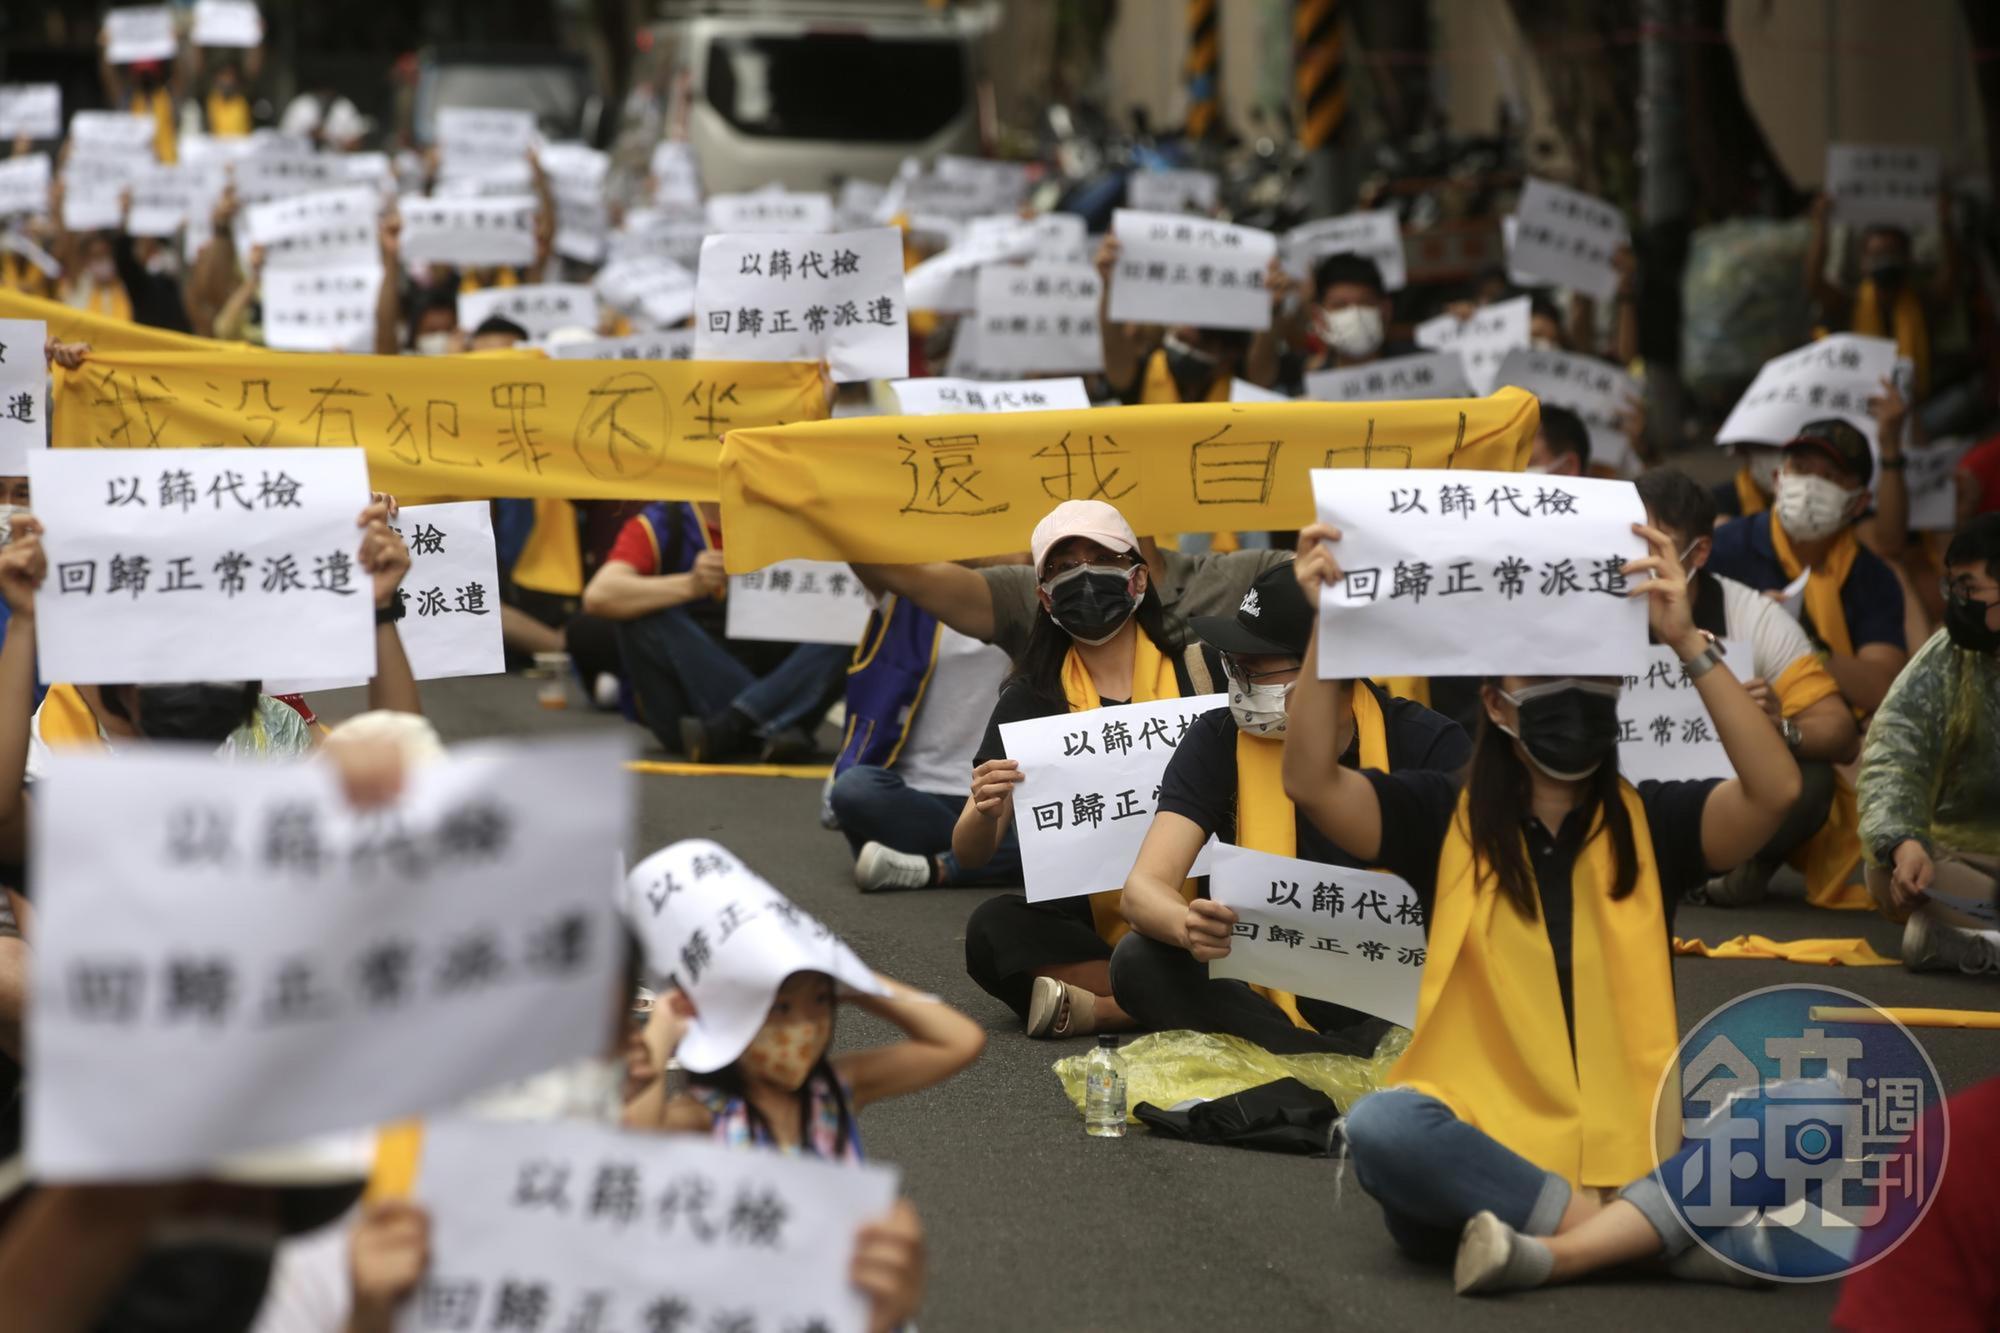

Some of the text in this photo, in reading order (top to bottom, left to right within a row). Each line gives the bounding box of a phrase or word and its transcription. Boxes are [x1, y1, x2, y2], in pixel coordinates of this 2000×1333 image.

[740, 248, 861, 281] 以篩代檢
[708, 296, 898, 337] 回歸正常派遣
[0, 391, 36, 424] 遣
[105, 469, 304, 513] 以篩代檢
[1387, 483, 1579, 520] 以篩代檢
[56, 548, 359, 600] 回歸正常派遣
[1343, 553, 1630, 605] 回歸正常派遣
[396, 581, 491, 619] 派遣
[1616, 714, 1720, 747] 正常派
[1031, 784, 1162, 832] 回歸正
[1266, 879, 1426, 928] 以篩代檢
[1231, 920, 1427, 968] 回歸正常派
